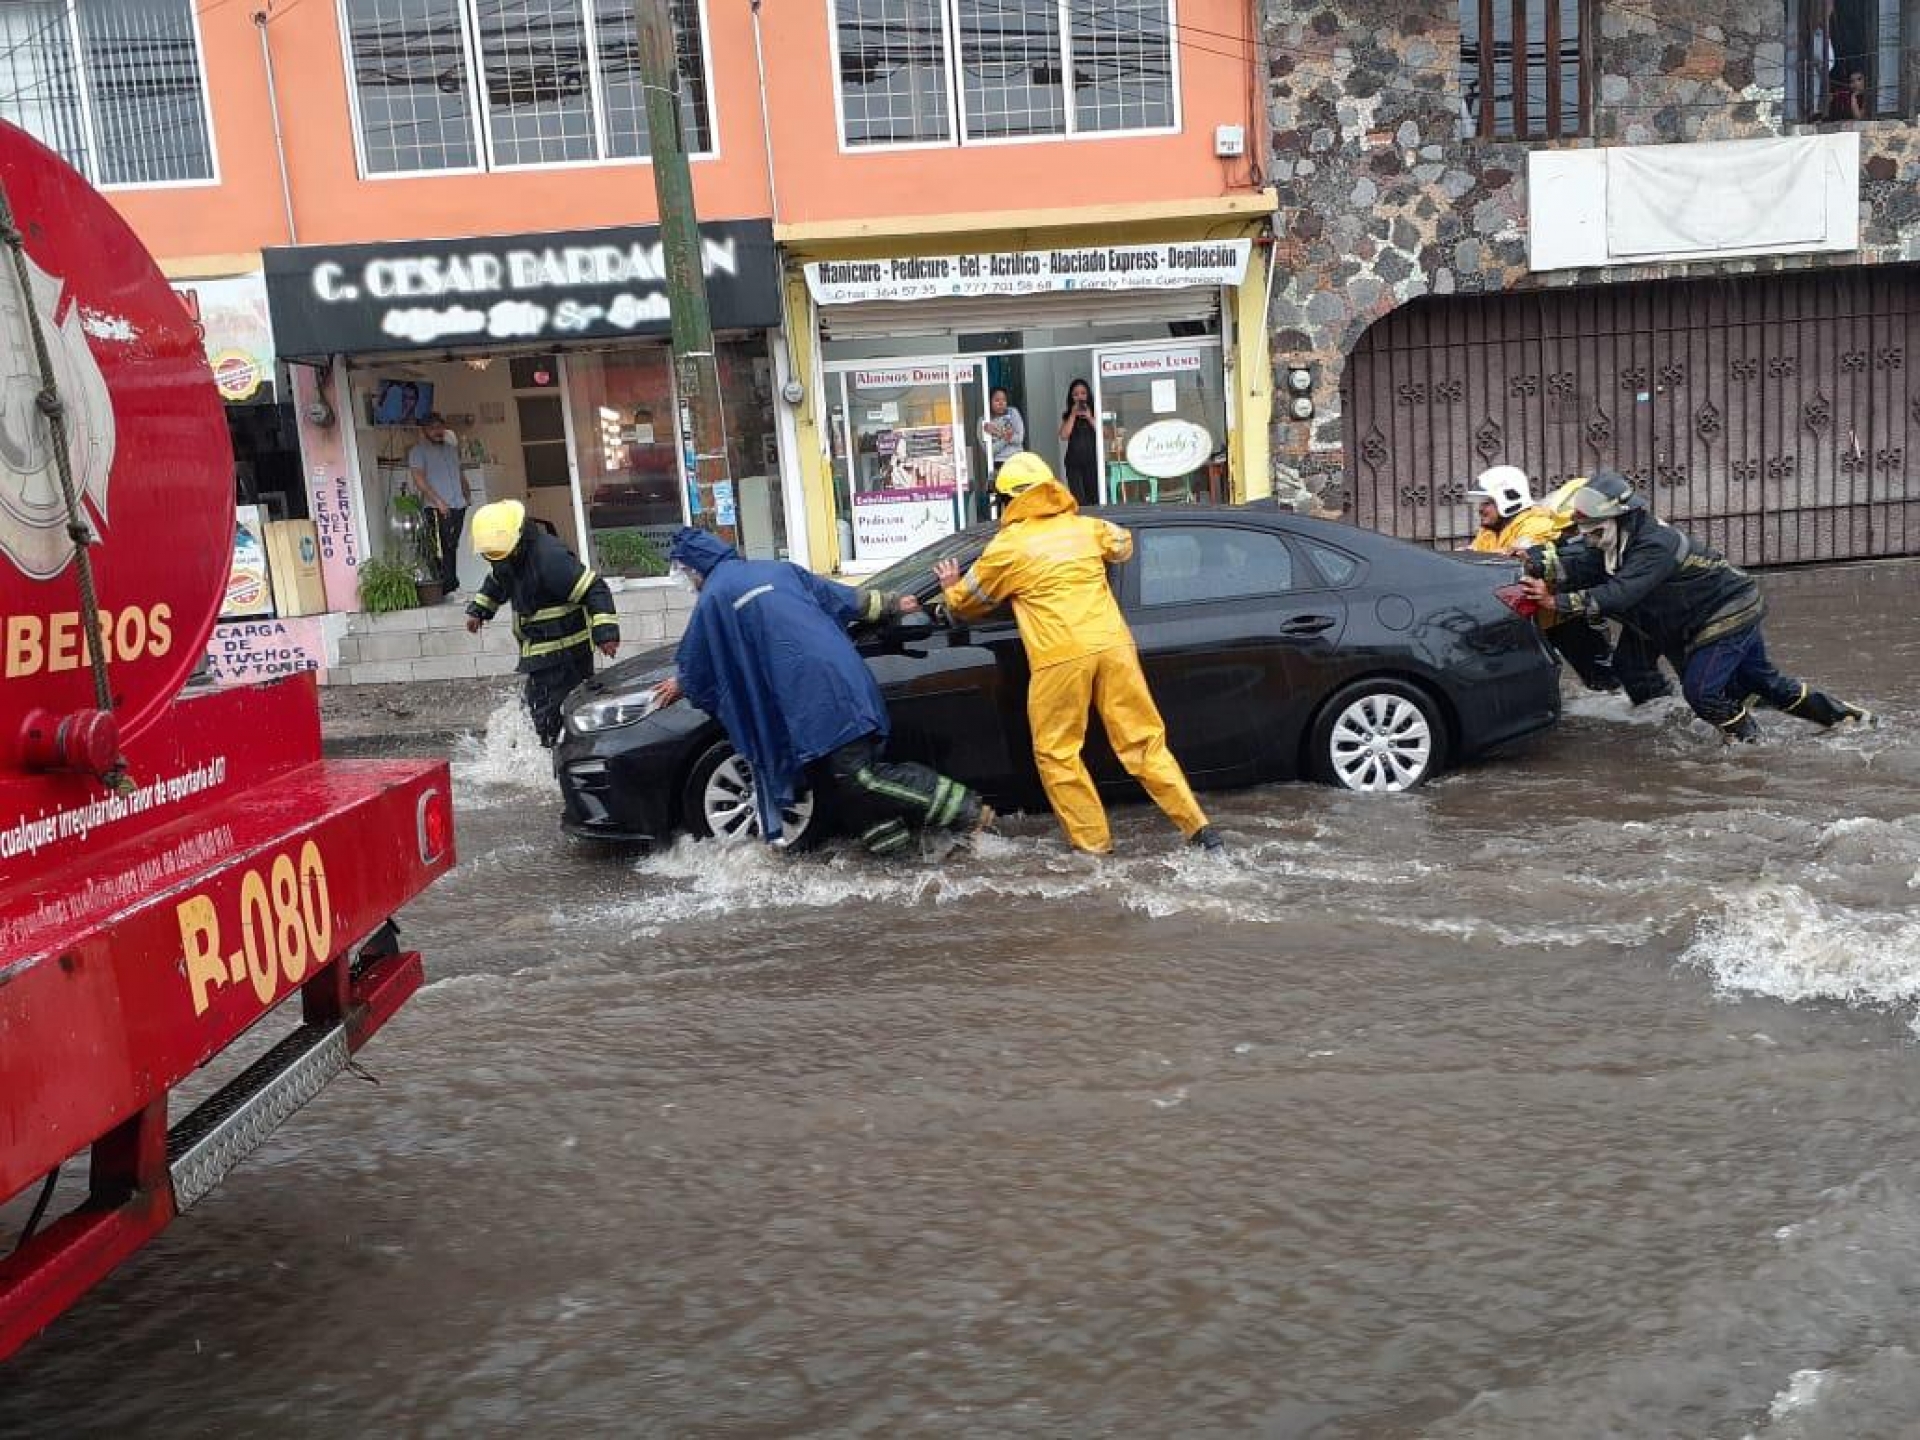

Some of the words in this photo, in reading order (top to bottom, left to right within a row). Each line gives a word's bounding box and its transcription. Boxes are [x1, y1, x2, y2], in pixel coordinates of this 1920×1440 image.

[364, 251, 501, 299] CESAR
[506, 236, 737, 289] BARRAN
[818, 261, 881, 284] Manicure
[890, 256, 949, 281] Pedicure
[959, 255, 980, 277] Gel
[1050, 250, 1106, 274] Alaciado
[1109, 249, 1158, 273] Express
[912, 369, 972, 381] DOMINOS
[316, 490, 333, 558] CENTRO
[336, 477, 356, 566] SERVICIO
[0, 602, 172, 678] BEROS
[207, 646, 306, 667] RTUCHOS
[210, 622, 286, 640] CARGA
[225, 639, 251, 651] DE
[0, 807, 57, 859] cualquier
[155, 773, 167, 807] de
[176, 840, 332, 1017] R-080
